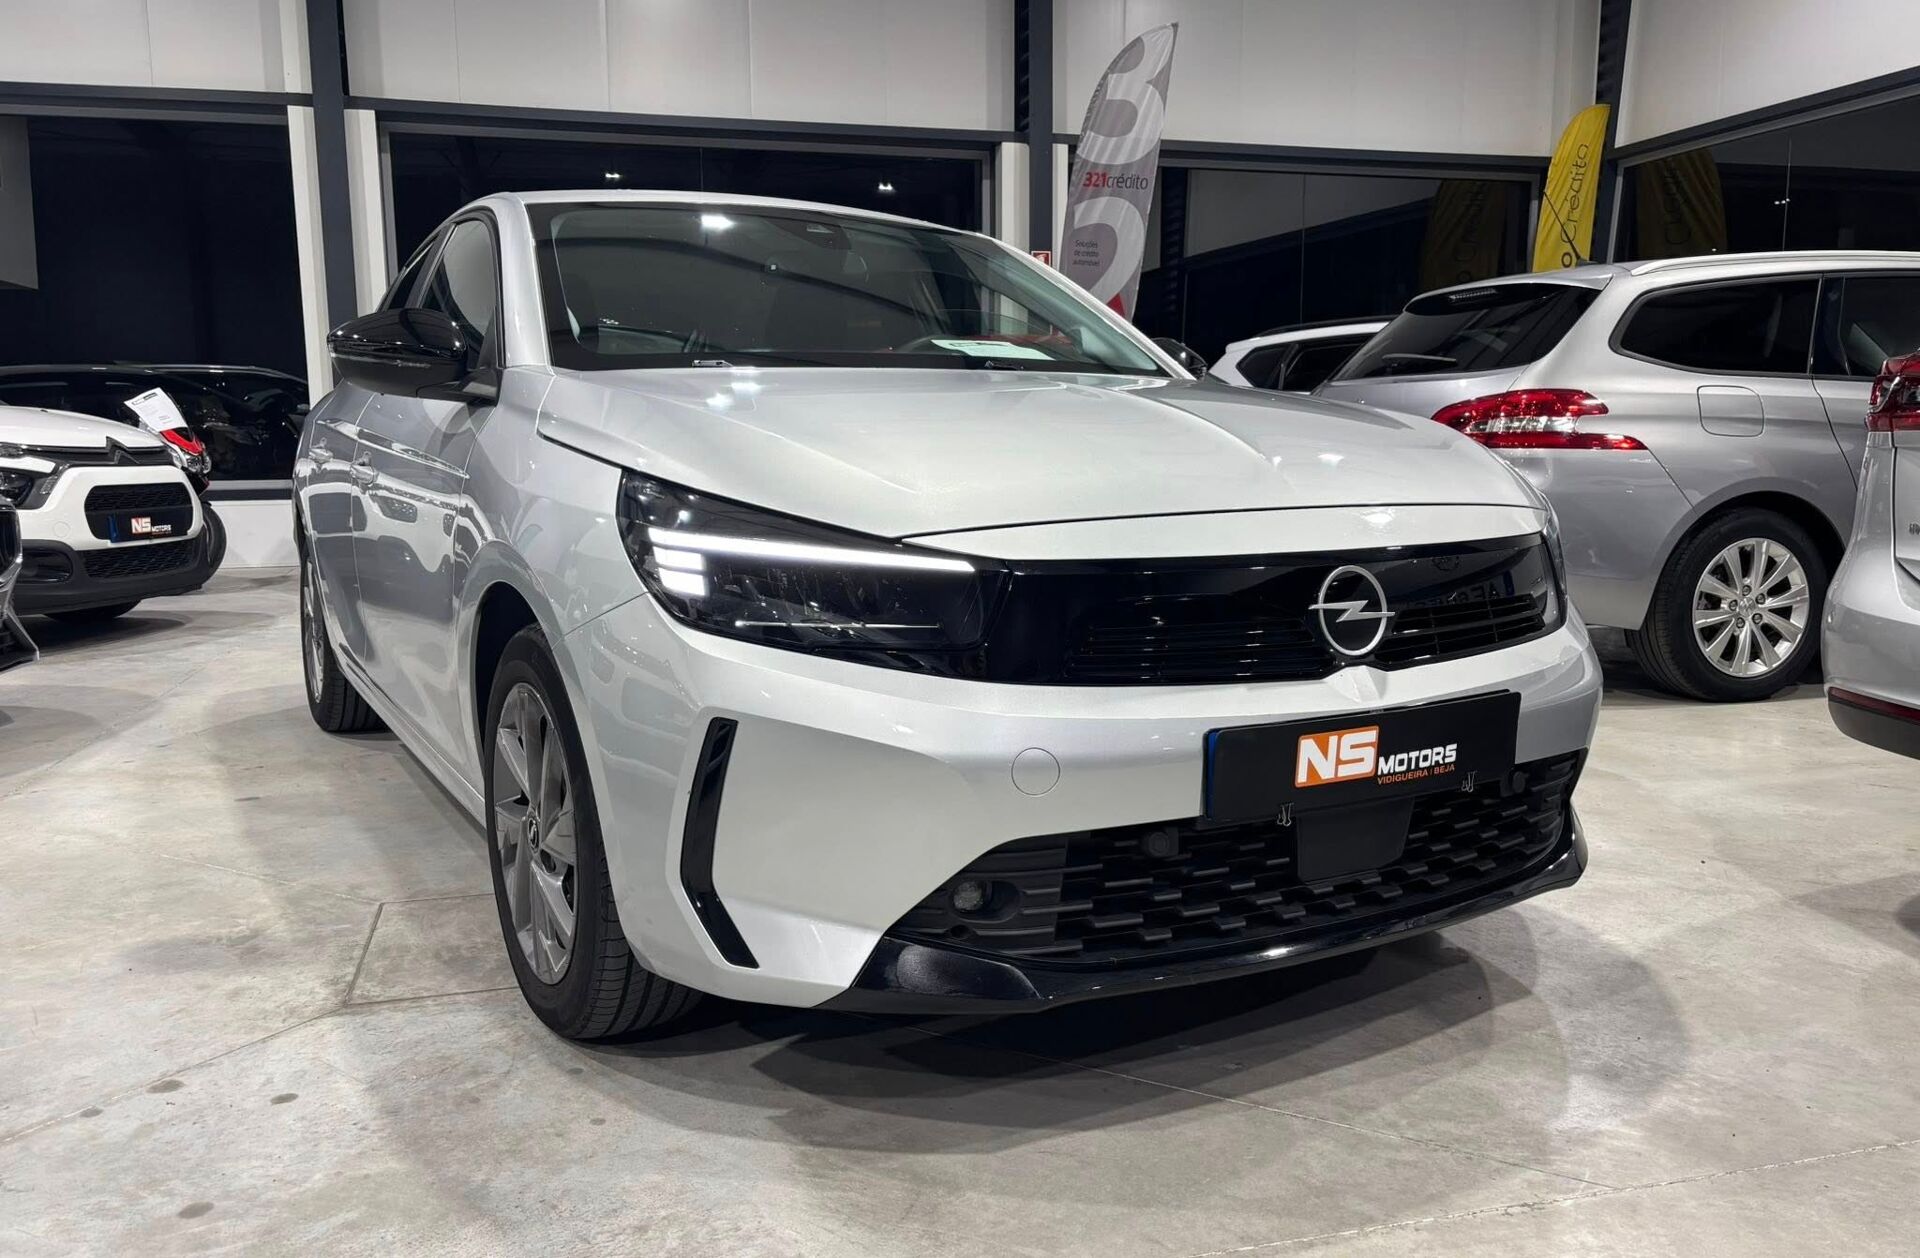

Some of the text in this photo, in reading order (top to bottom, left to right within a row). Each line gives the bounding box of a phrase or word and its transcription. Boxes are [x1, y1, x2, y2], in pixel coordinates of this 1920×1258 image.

[1082, 171, 1149, 190] 321crédito
[131, 516, 151, 534] NS
[1298, 730, 1377, 783] NS
[1377, 743, 1457, 775] MOTORS
[1377, 770, 1428, 785] VIDIGUEIRA
[1434, 764, 1455, 776] BEJA
